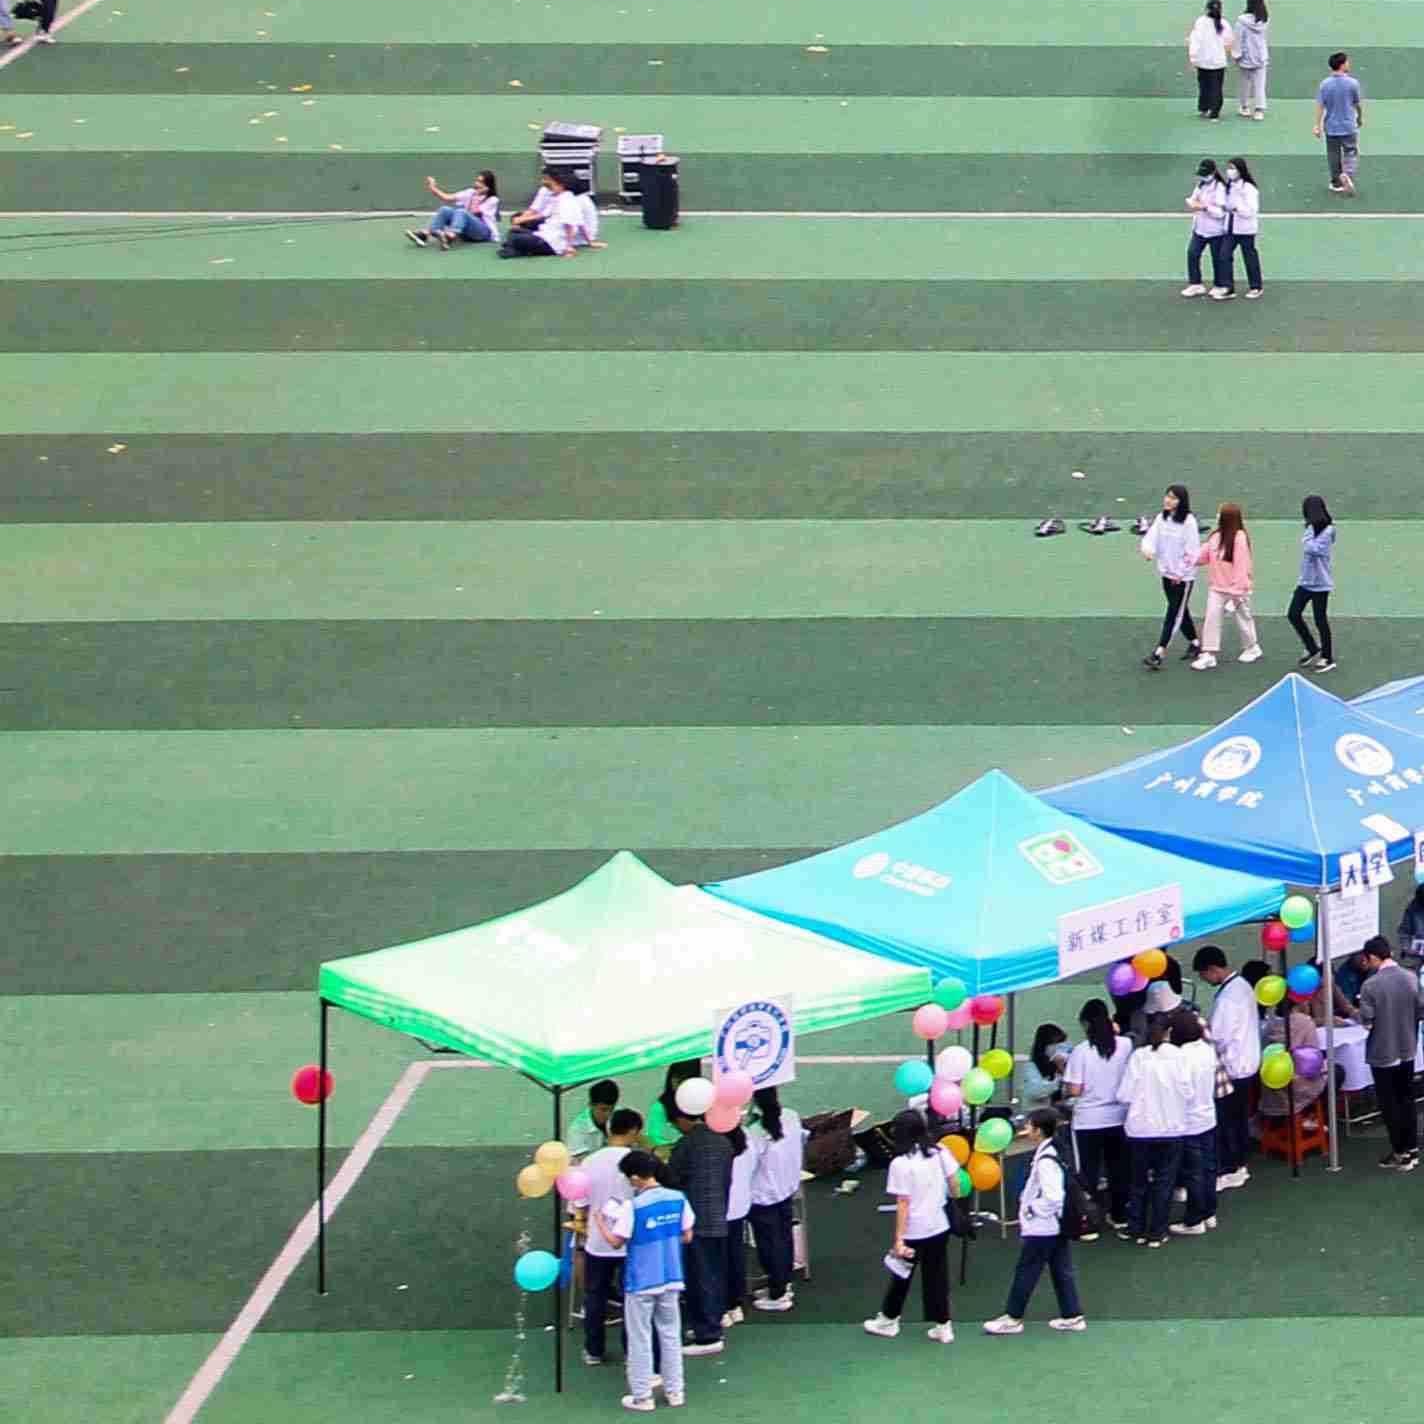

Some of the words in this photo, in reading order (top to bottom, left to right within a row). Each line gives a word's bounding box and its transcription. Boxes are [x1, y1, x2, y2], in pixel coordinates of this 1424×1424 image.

[1145, 773, 1263, 808] 广州商学院
[1067, 903, 1175, 952] 新媒工作室
